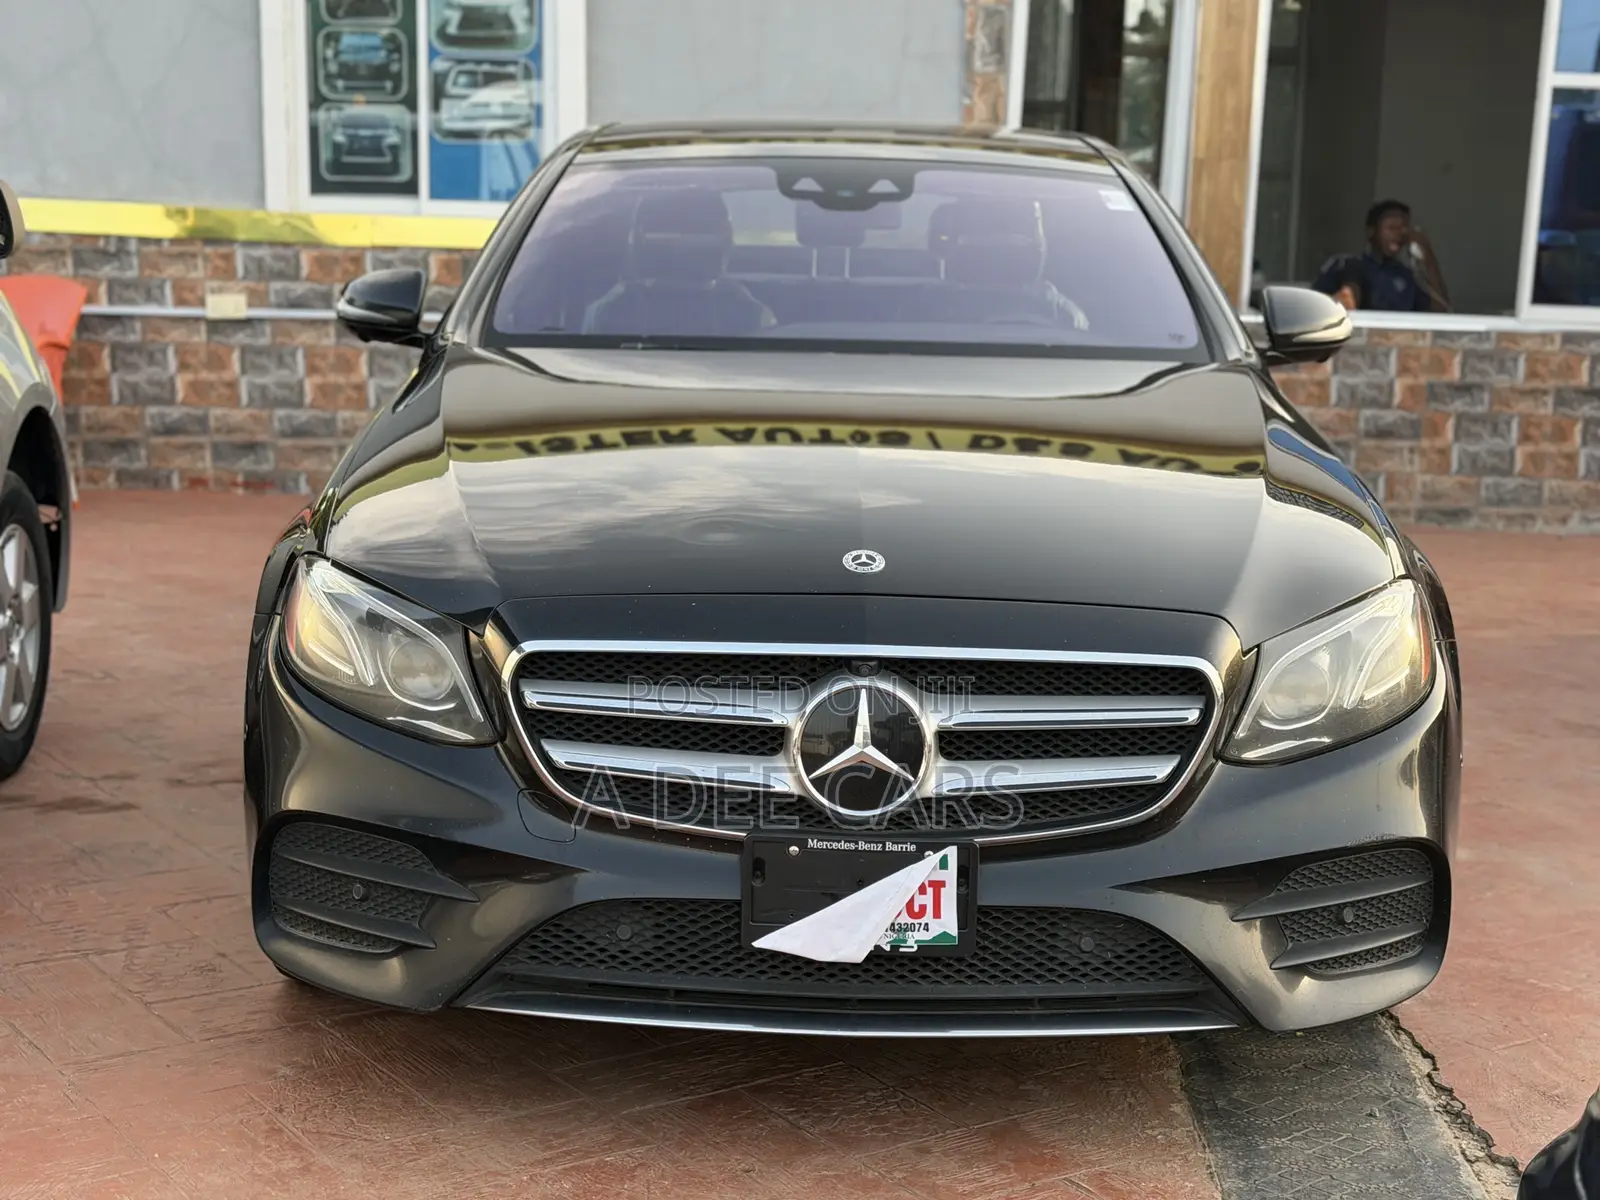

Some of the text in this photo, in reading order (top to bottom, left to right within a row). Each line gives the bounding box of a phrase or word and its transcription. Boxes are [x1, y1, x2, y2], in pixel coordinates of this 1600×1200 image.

[807, 838, 917, 852] Mercedes-Benz Barrie
[896, 880, 947, 920] CT
